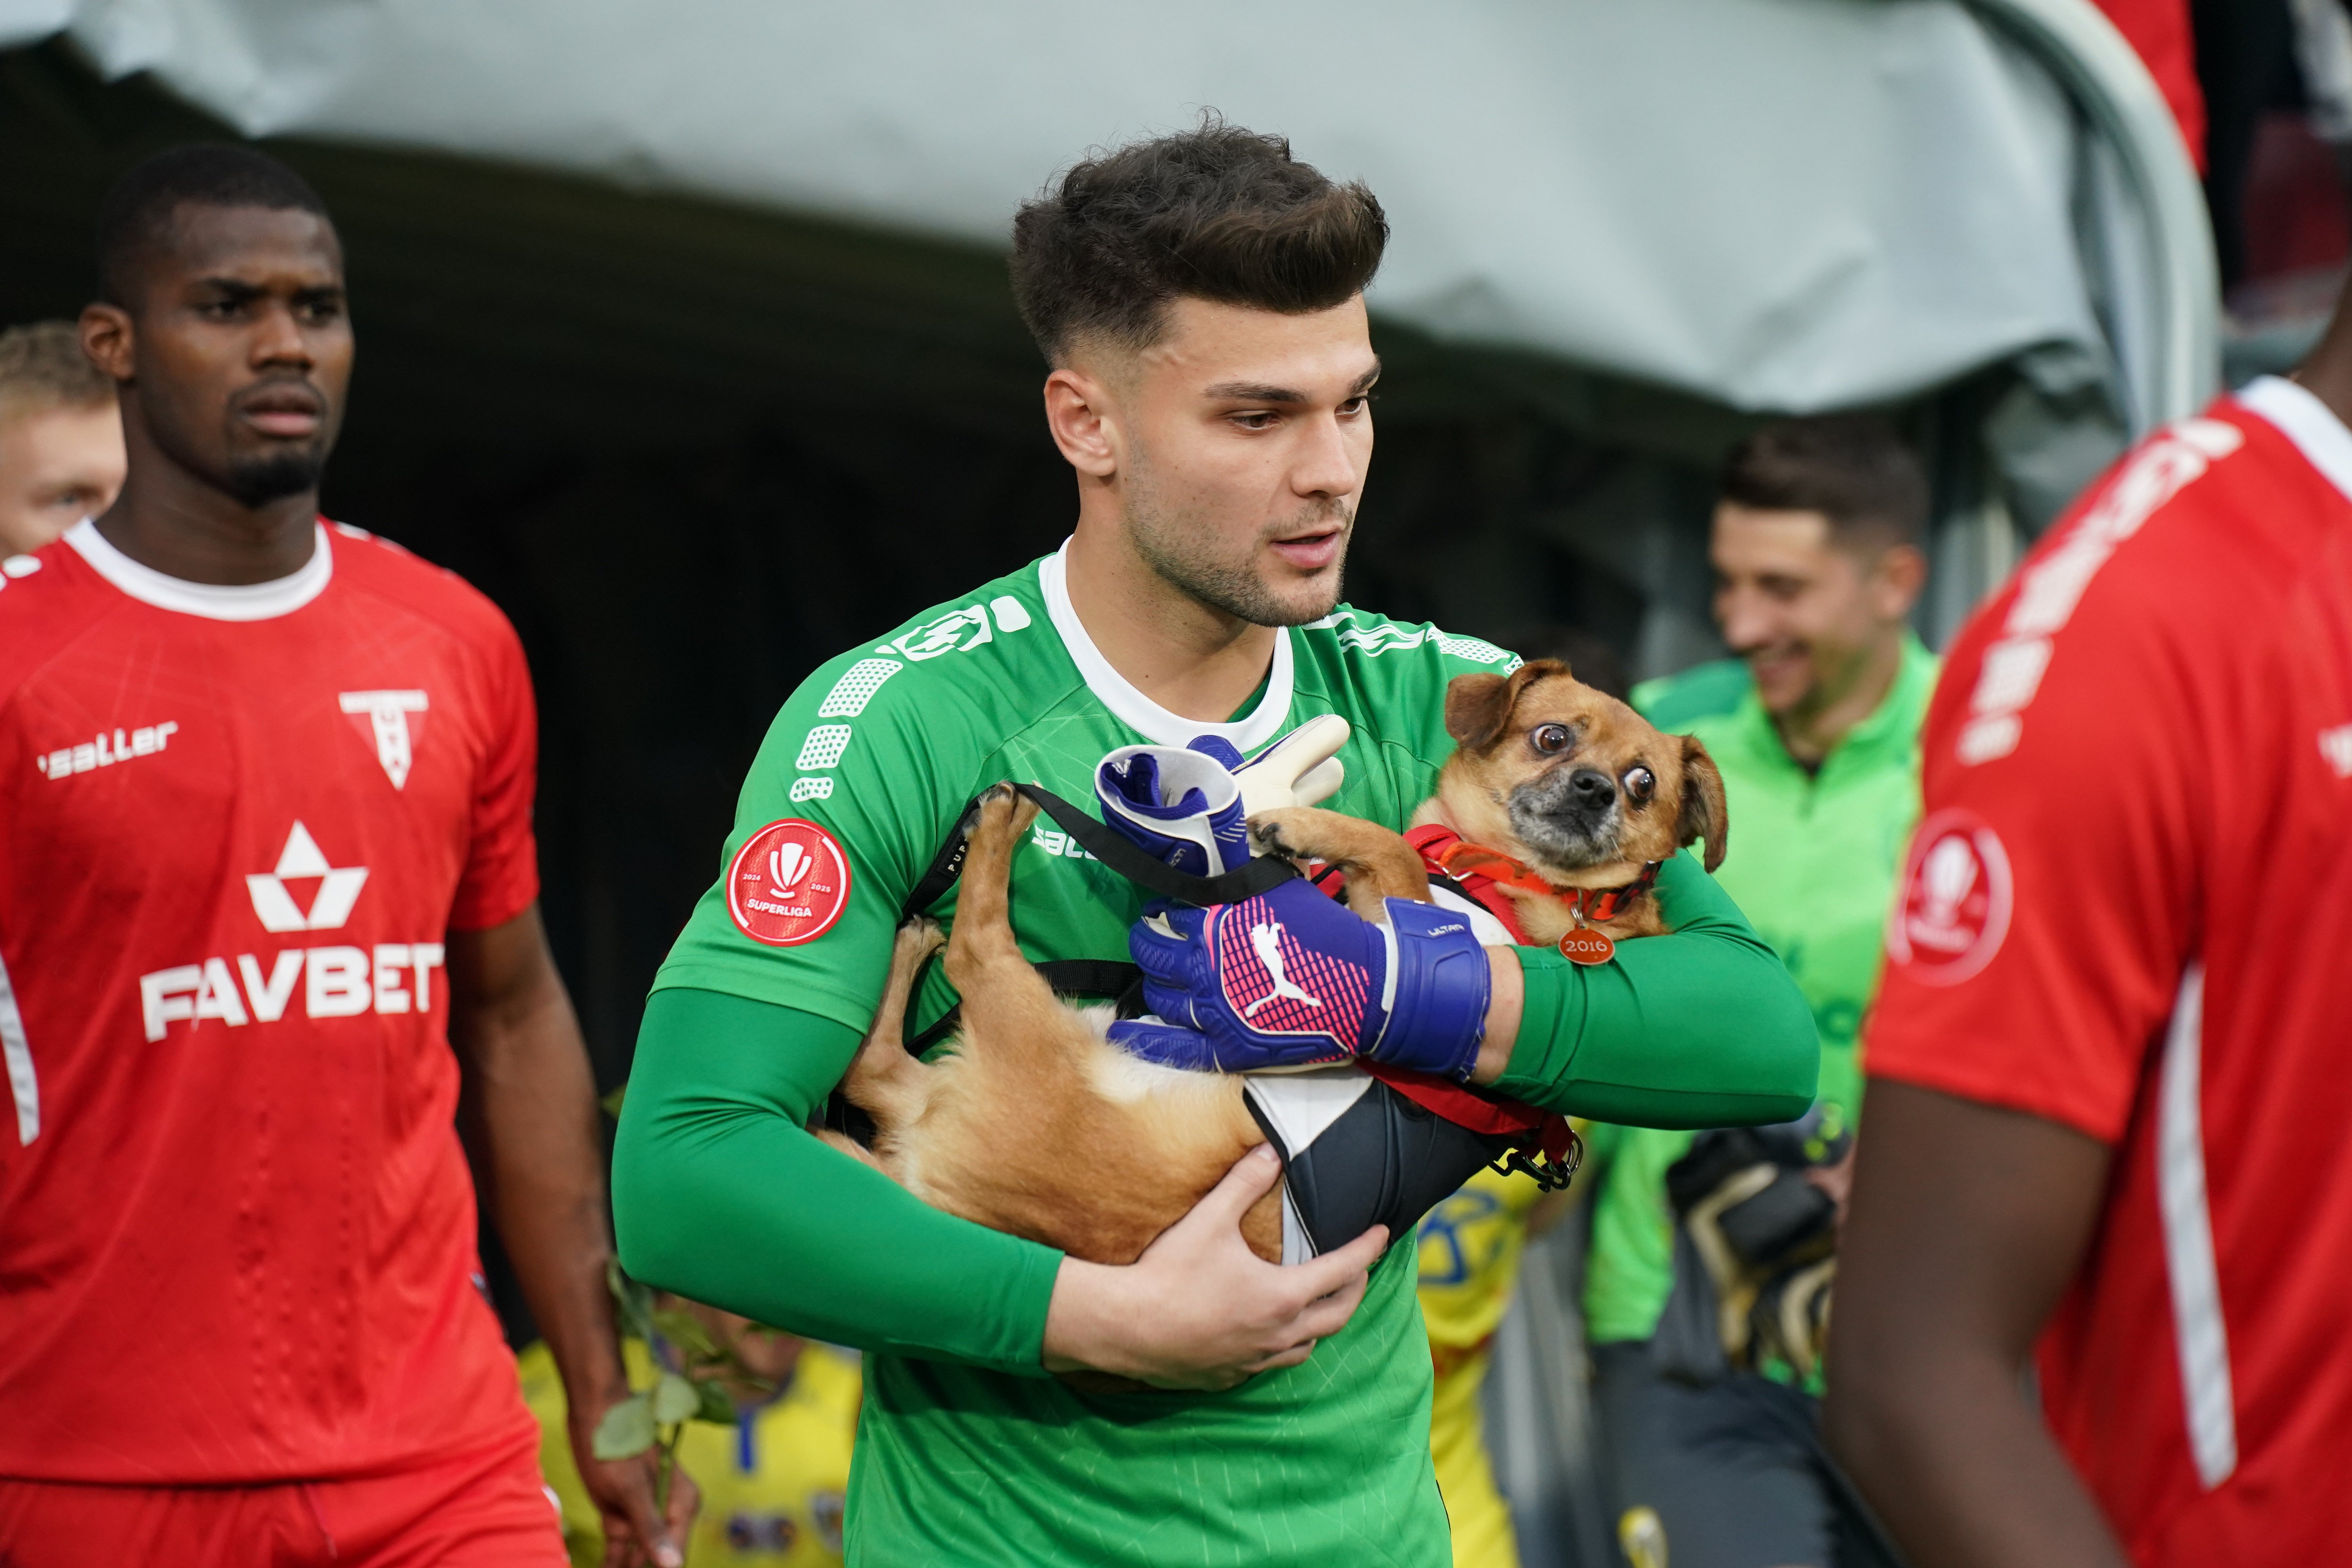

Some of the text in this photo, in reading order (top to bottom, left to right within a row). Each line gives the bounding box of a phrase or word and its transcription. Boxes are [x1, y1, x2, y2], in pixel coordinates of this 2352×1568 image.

[47, 720, 179, 780] saller
[947, 837, 967, 872] PUP
[1031, 824, 1099, 860] sal
[810, 883, 831, 893] 2025
[747, 898, 812, 917] SUPERLIGA
[1427, 924, 1465, 936] ULTRA
[1564, 940, 1608, 952] 2016
[139, 943, 445, 1043] FAVBET
